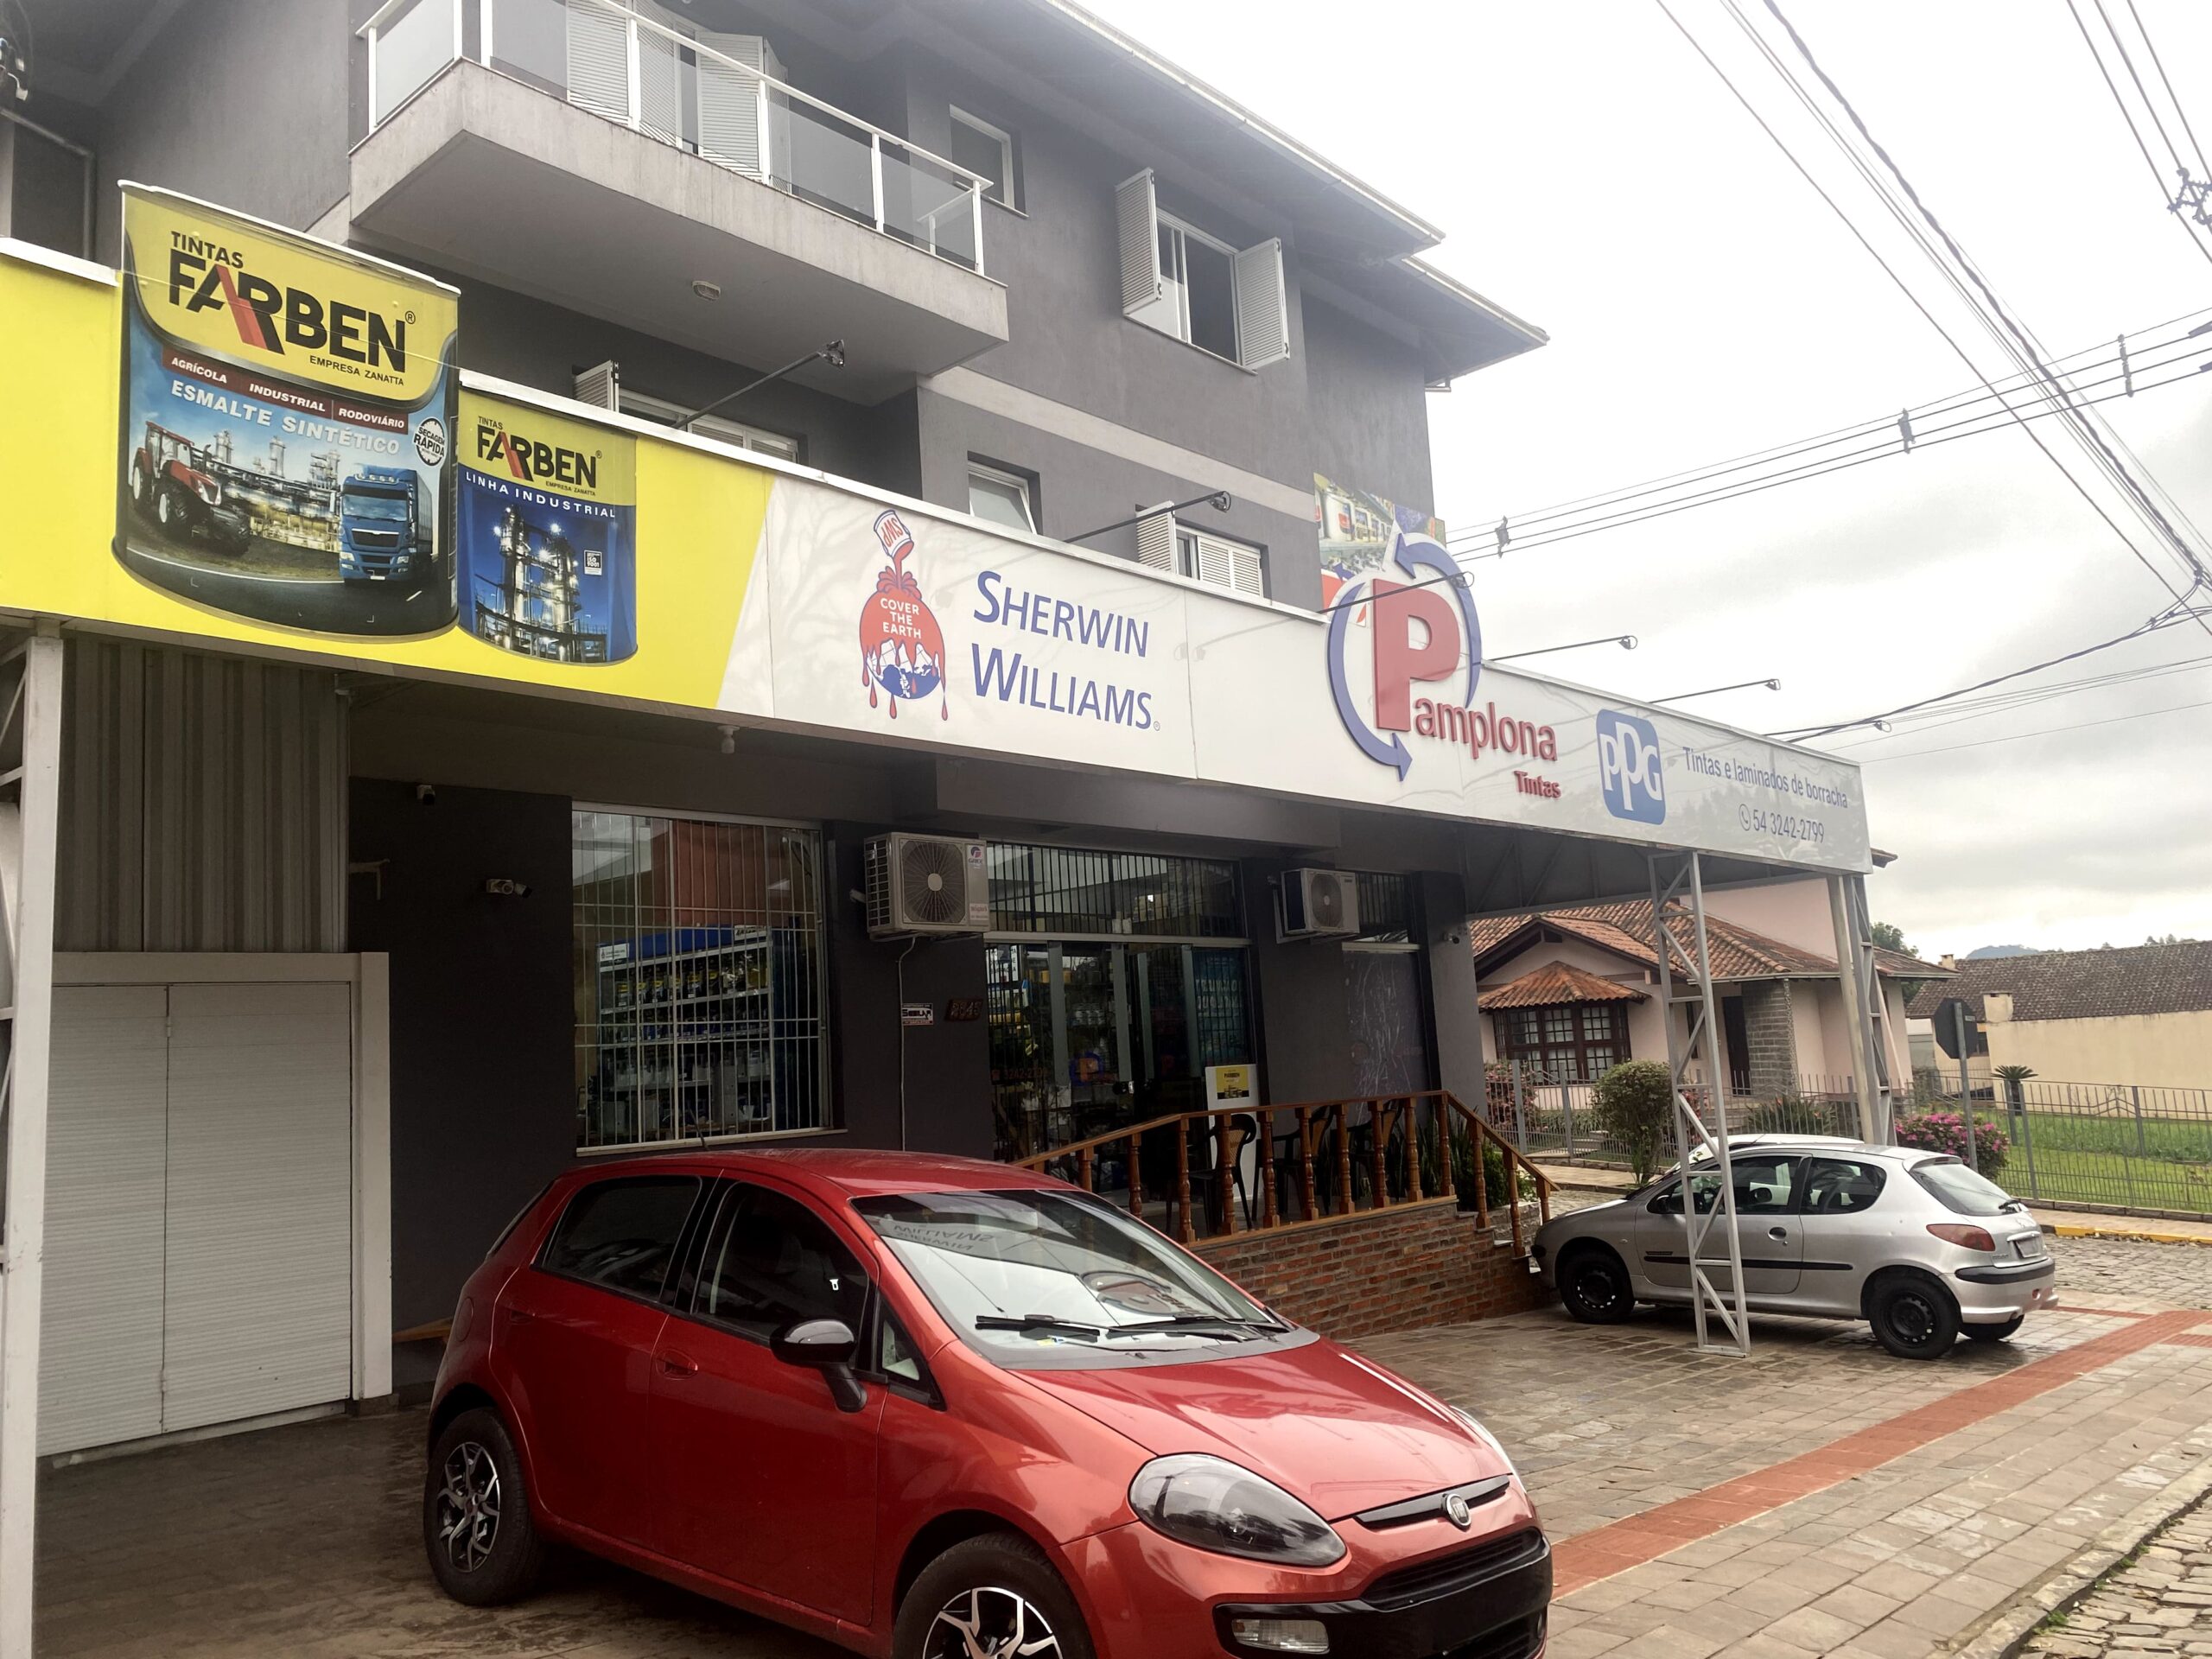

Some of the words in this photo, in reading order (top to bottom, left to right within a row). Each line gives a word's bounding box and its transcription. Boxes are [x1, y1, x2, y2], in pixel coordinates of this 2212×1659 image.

[171, 230, 244, 269] TINTAS
[169, 248, 406, 373] FARBEN
[309, 355, 360, 376] EMPRESA
[364, 370, 404, 386] ZANATTA
[171, 357, 227, 384] AGRÍCOLA
[249, 383, 326, 412] INDUSTRIAL
[338, 407, 405, 429] RODOVIÁRIO
[171, 380, 273, 427] ESMALTE
[282, 415, 400, 455] SINTÉTICO
[478, 416, 503, 430] TINTAS
[418, 427, 445, 446] SECAGEM
[477, 424, 596, 489] FARBEN
[466, 472, 509, 495] LINHA
[515, 488, 615, 518] INDUSTRIAL
[545, 480, 572, 492] EMPRESA
[574, 487, 596, 497] ZANATTA
[880, 517, 904, 548] SWP
[880, 598, 920, 616] COVER
[890, 611, 913, 626] THE
[973, 570, 1148, 658] SHERWIN
[882, 621, 922, 639] EARTH
[971, 642, 1153, 730] WILLIAMS
[1373, 578, 1559, 761] Pamplona
[1513, 770, 1562, 799] Tintas
[1682, 746, 1722, 778] Tintas
[1724, 761, 1732, 779] e
[1733, 757, 1789, 791] laminados
[1791, 773, 1804, 797] de
[1806, 782, 1848, 809] borracha
[1752, 809, 1767, 832] 54
[1770, 811, 1825, 844] 3242-2799
